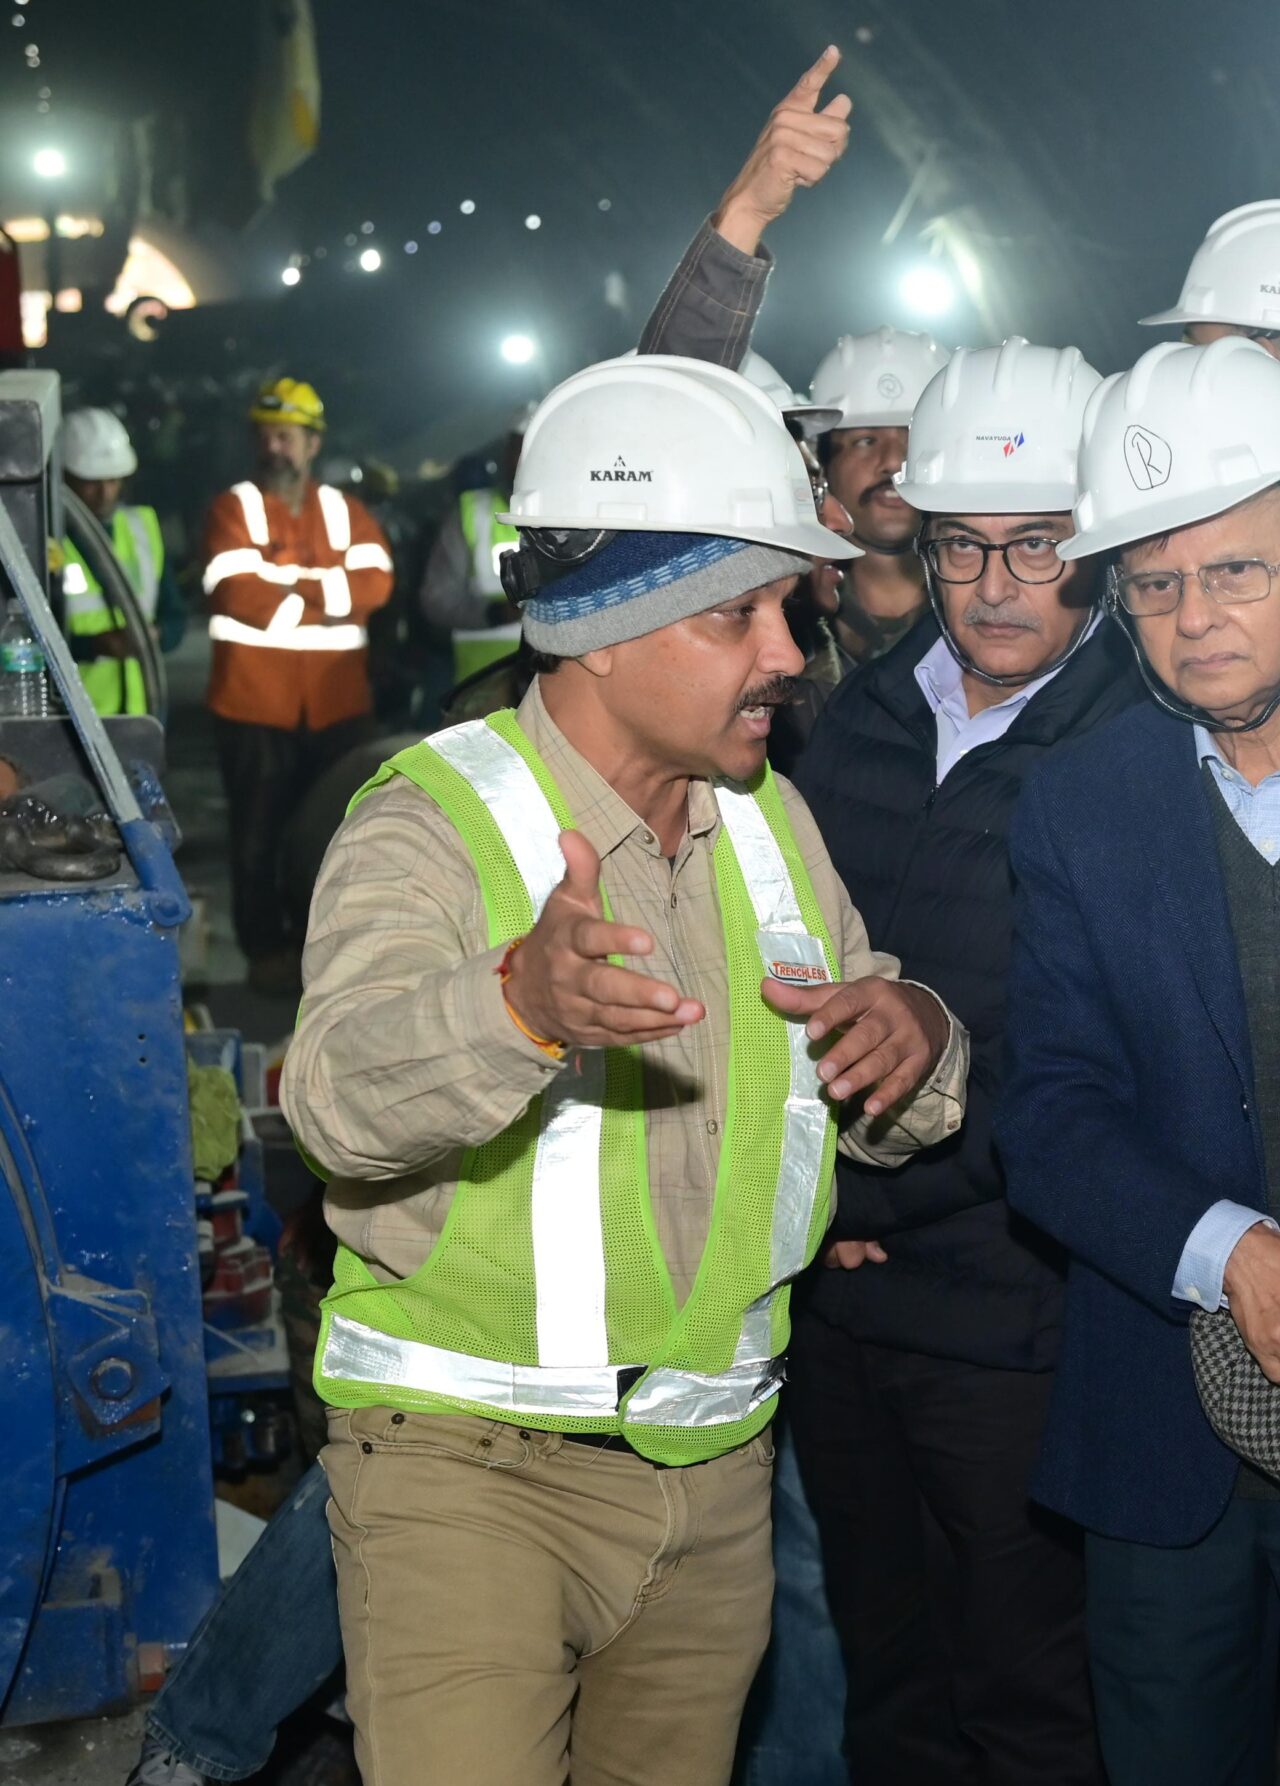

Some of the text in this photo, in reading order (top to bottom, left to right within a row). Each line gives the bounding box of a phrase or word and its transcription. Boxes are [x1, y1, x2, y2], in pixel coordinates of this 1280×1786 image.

[1131, 431, 1163, 489] R
[590, 470, 653, 482] KARAM
[772, 961, 827, 981] TRENCHLESS
